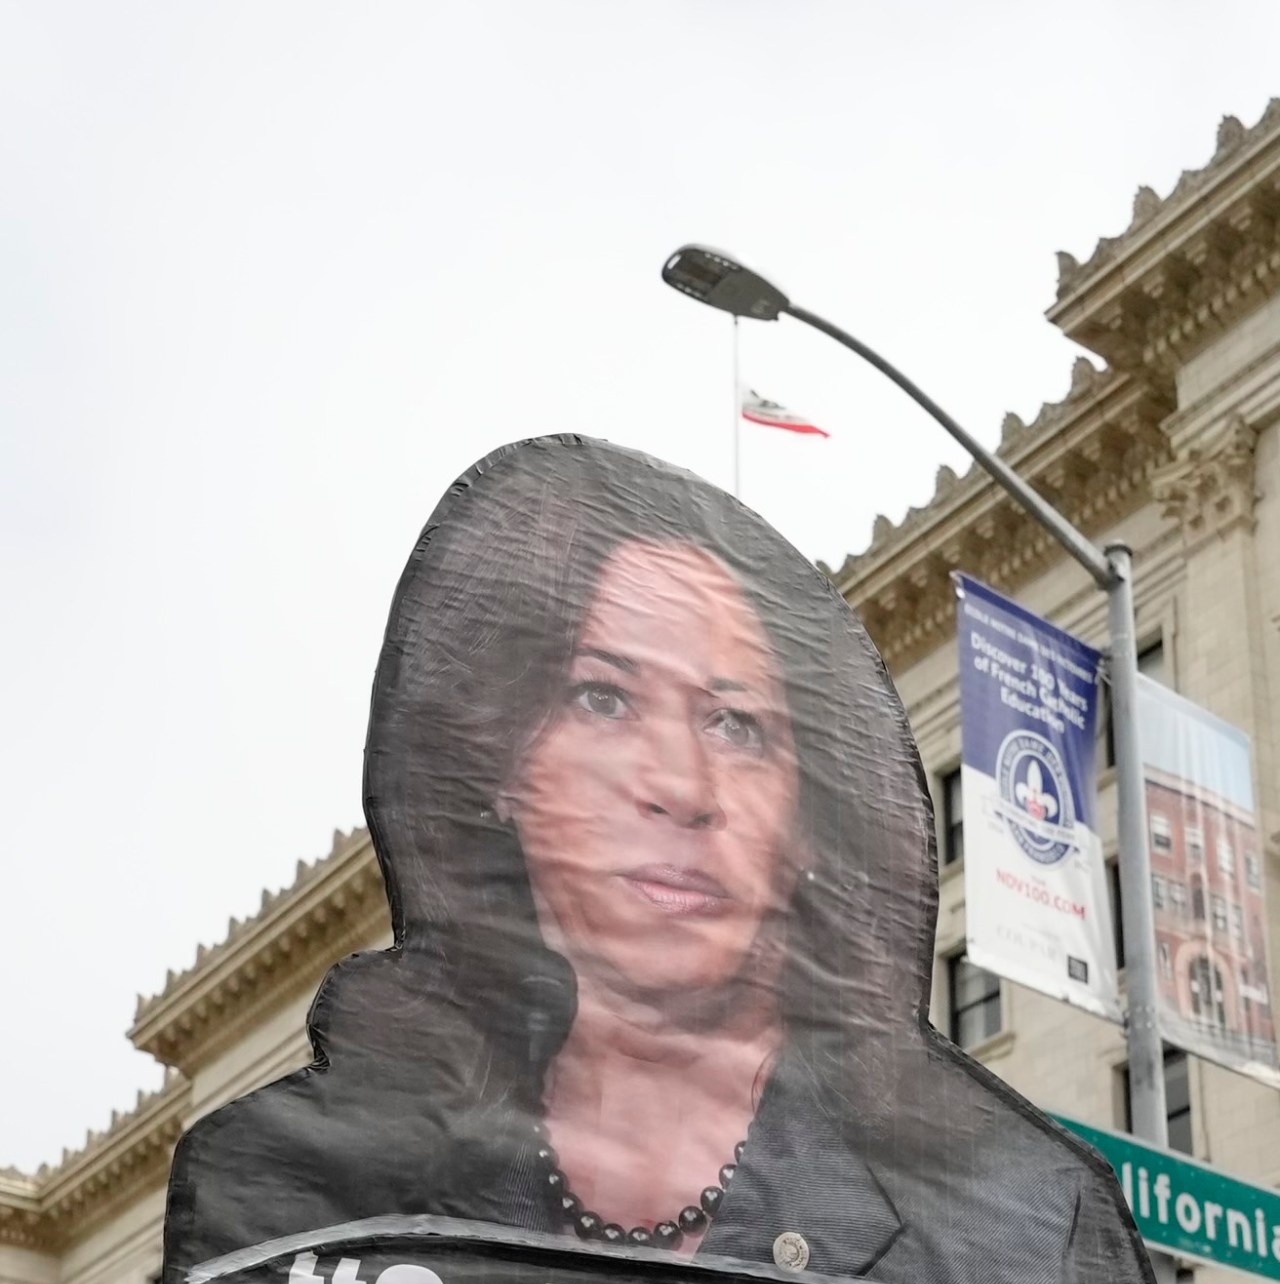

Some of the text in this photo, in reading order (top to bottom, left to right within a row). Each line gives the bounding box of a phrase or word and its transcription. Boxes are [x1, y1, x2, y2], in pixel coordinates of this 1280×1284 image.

[971, 631, 1027, 674] Discover
[974, 656, 1085, 730] of French Catholic
[1001, 686, 1065, 733] Education
